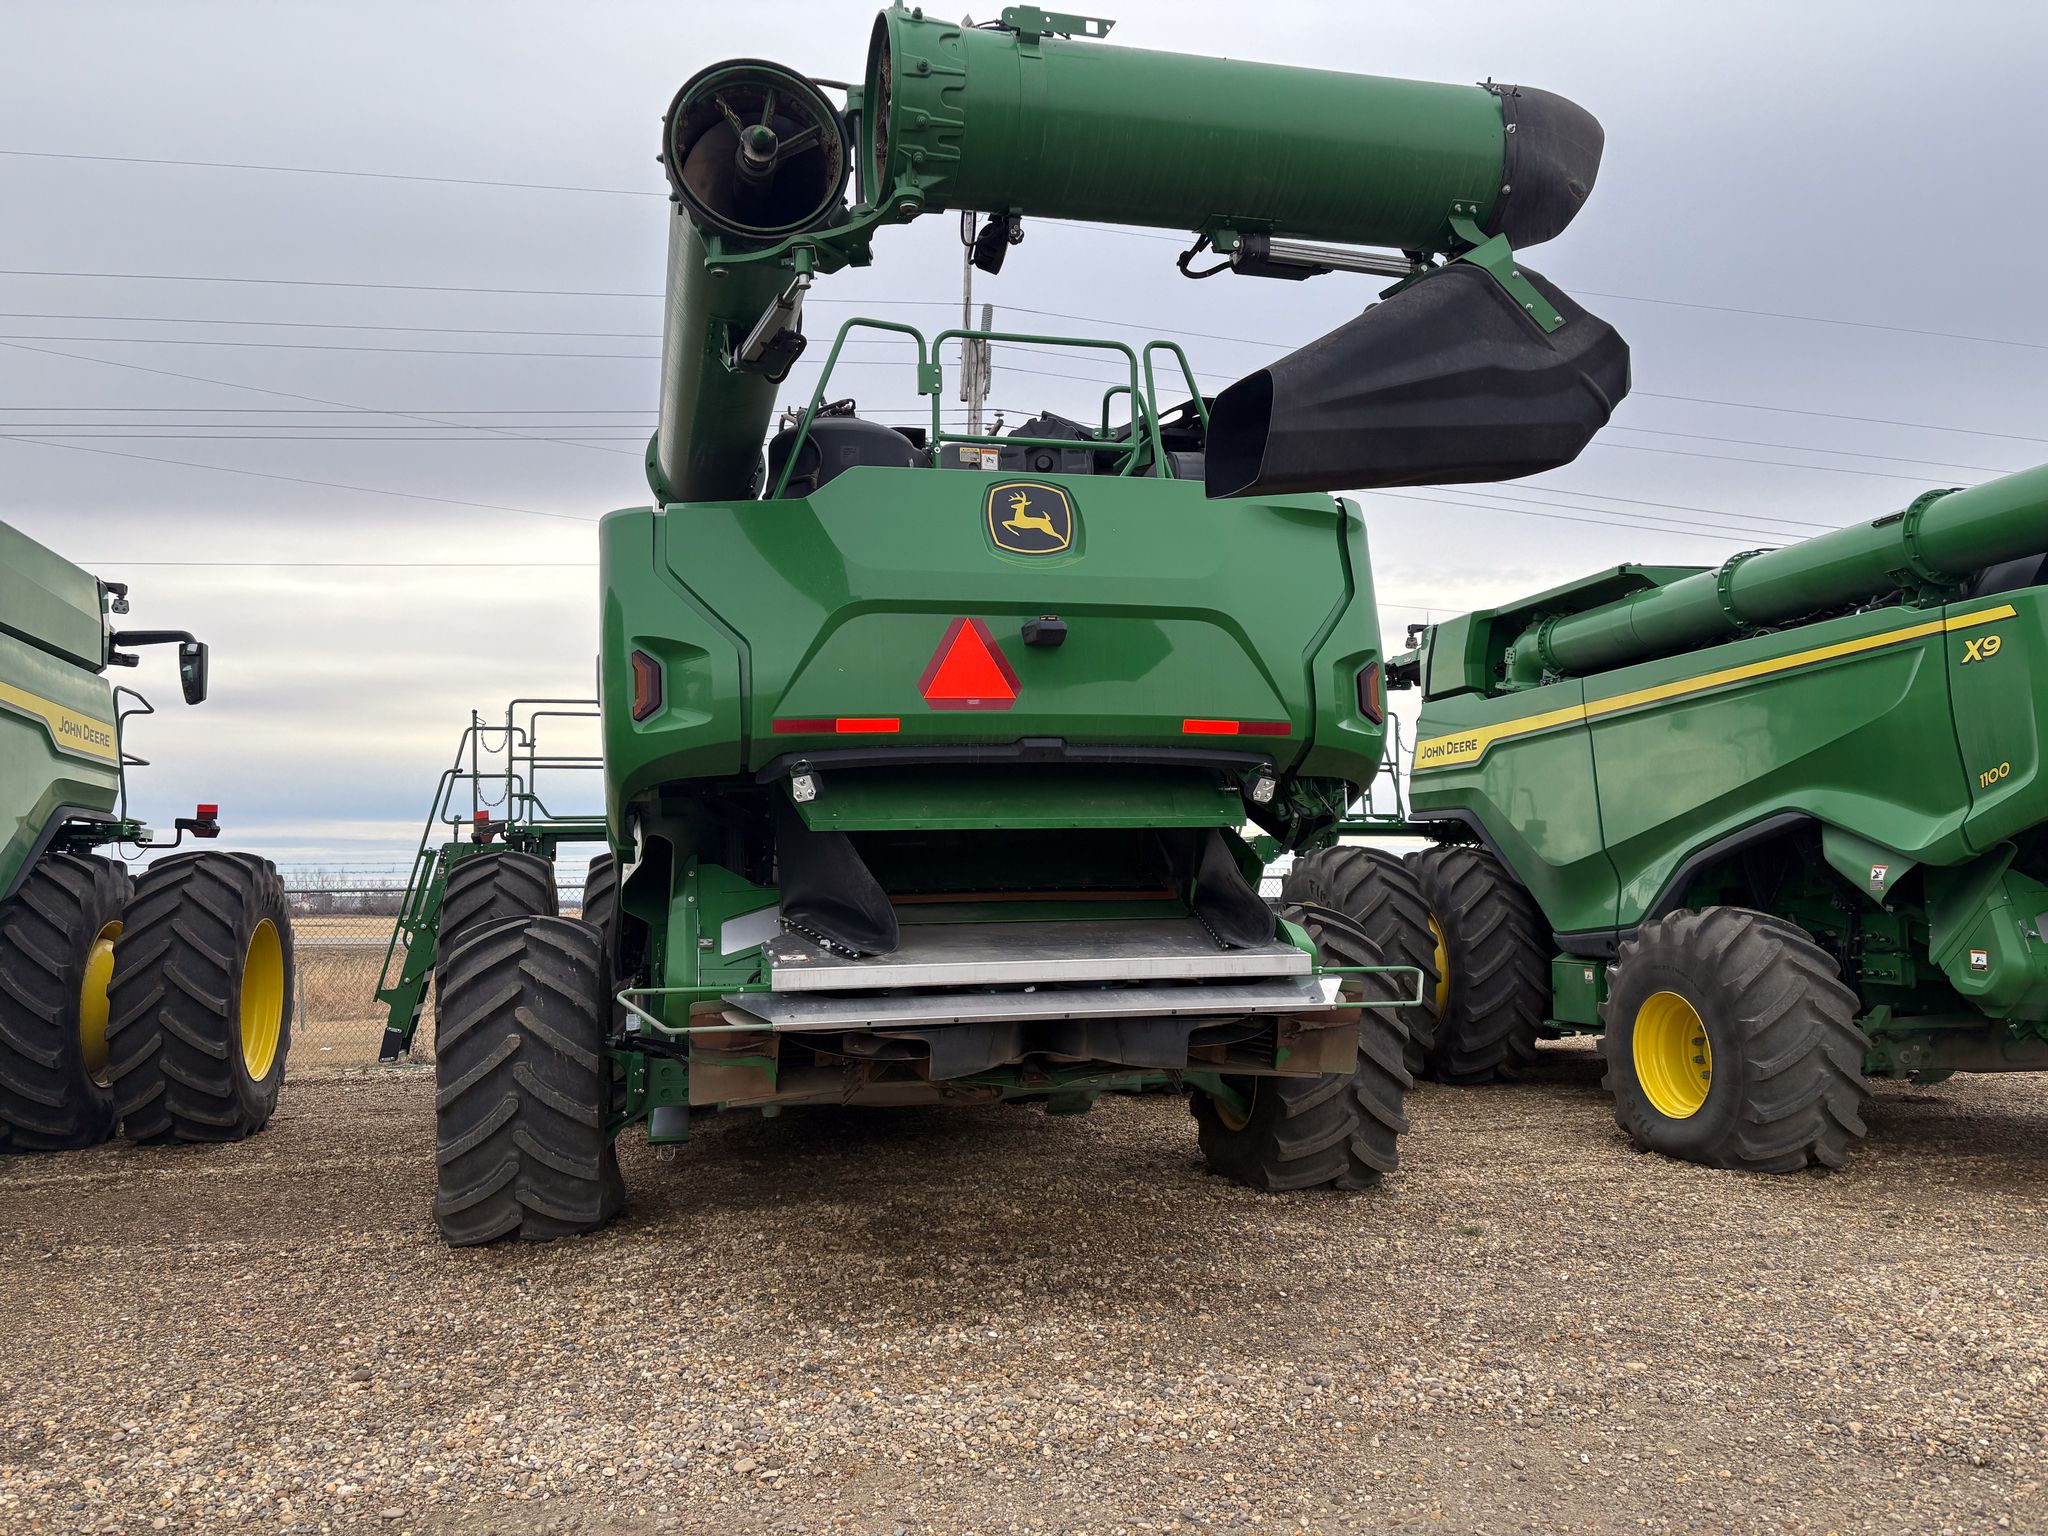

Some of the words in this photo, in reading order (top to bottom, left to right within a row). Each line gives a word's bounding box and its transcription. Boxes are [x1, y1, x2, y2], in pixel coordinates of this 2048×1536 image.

[1960, 635, 2002, 666] X9
[58, 716, 82, 739] JOHN
[83, 724, 110, 748] DEERE
[1421, 745, 1445, 760] JOHN
[1446, 739, 1478, 755] DEERE
[1979, 762, 2010, 789] 1100
